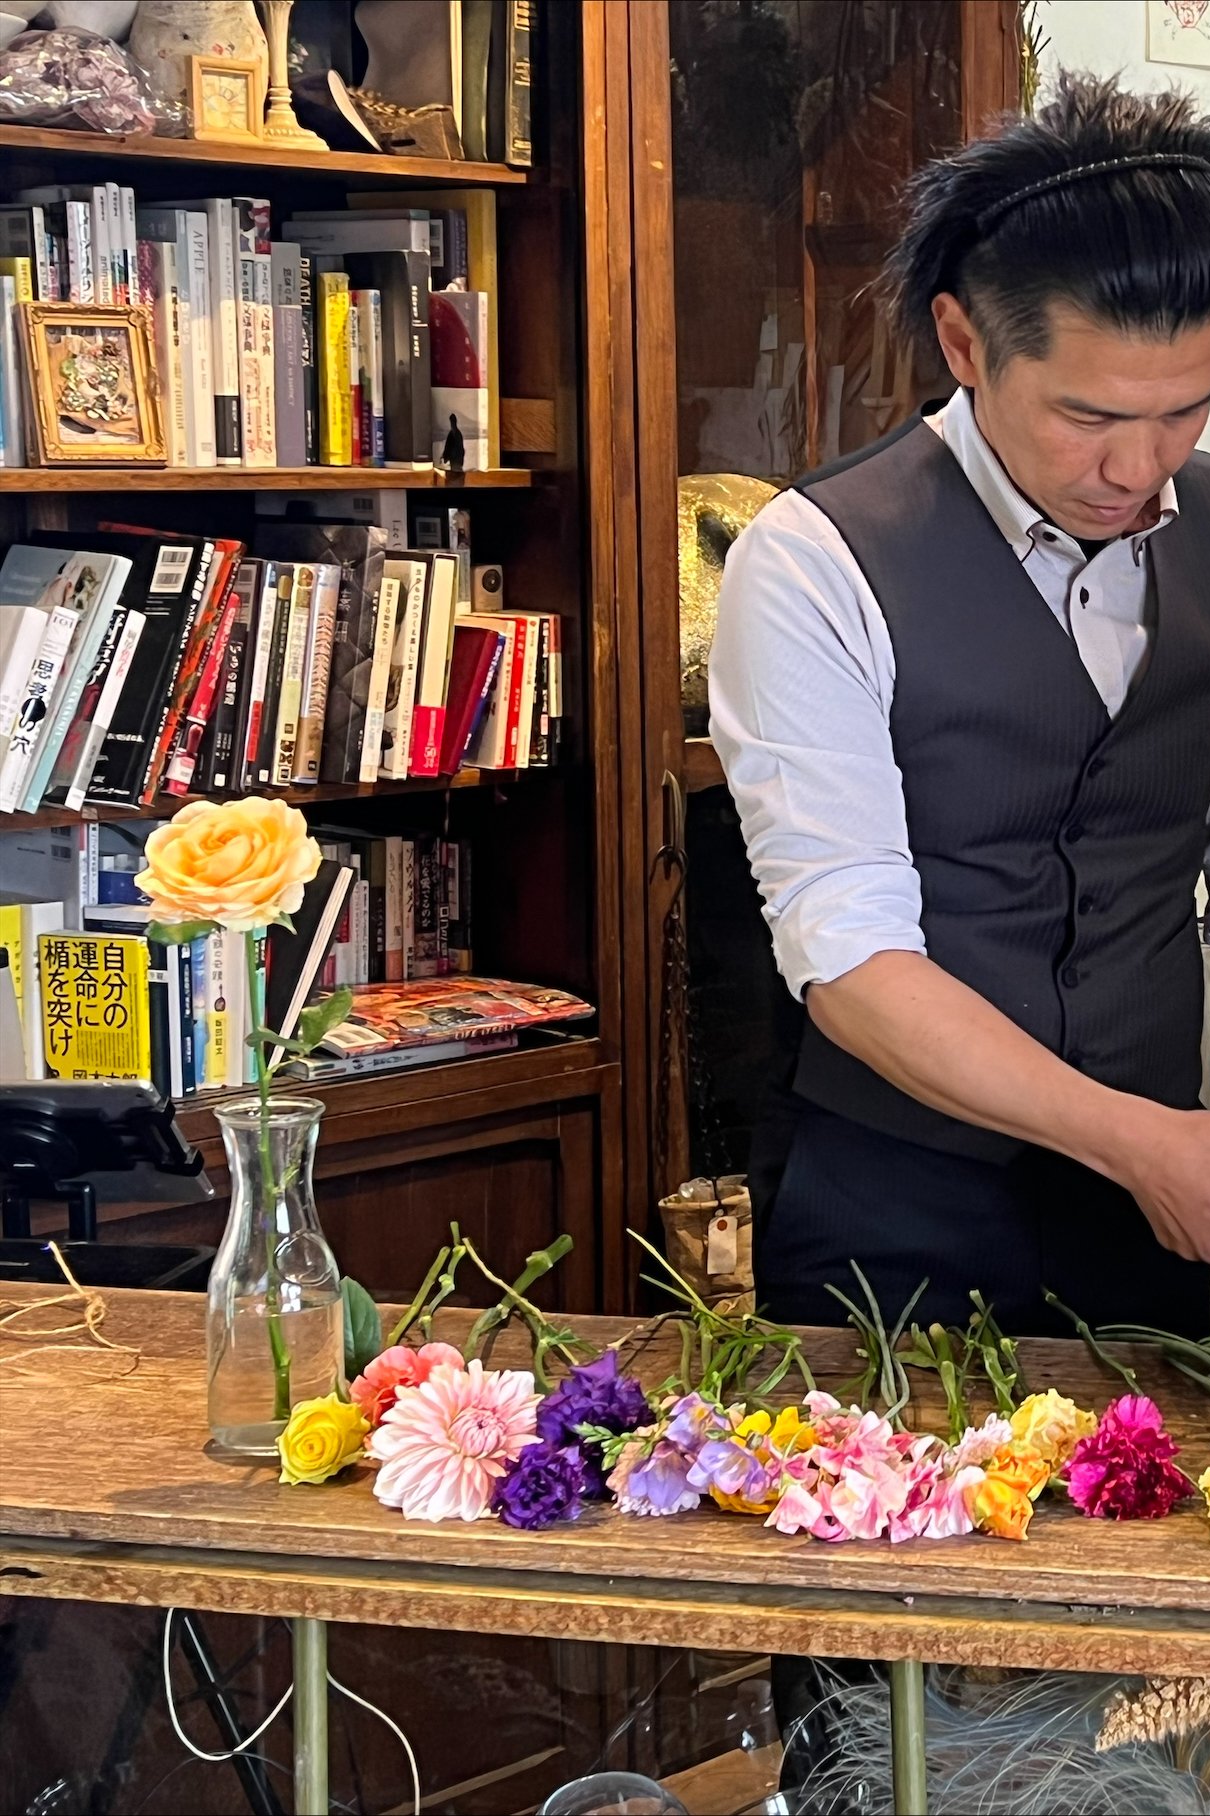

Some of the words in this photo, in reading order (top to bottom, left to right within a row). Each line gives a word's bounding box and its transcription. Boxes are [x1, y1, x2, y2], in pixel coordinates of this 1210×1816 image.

[44, 940, 73, 1057] 楯を突け
[72, 941, 99, 1027] 運命に
[101, 942, 128, 1029] 自分の
